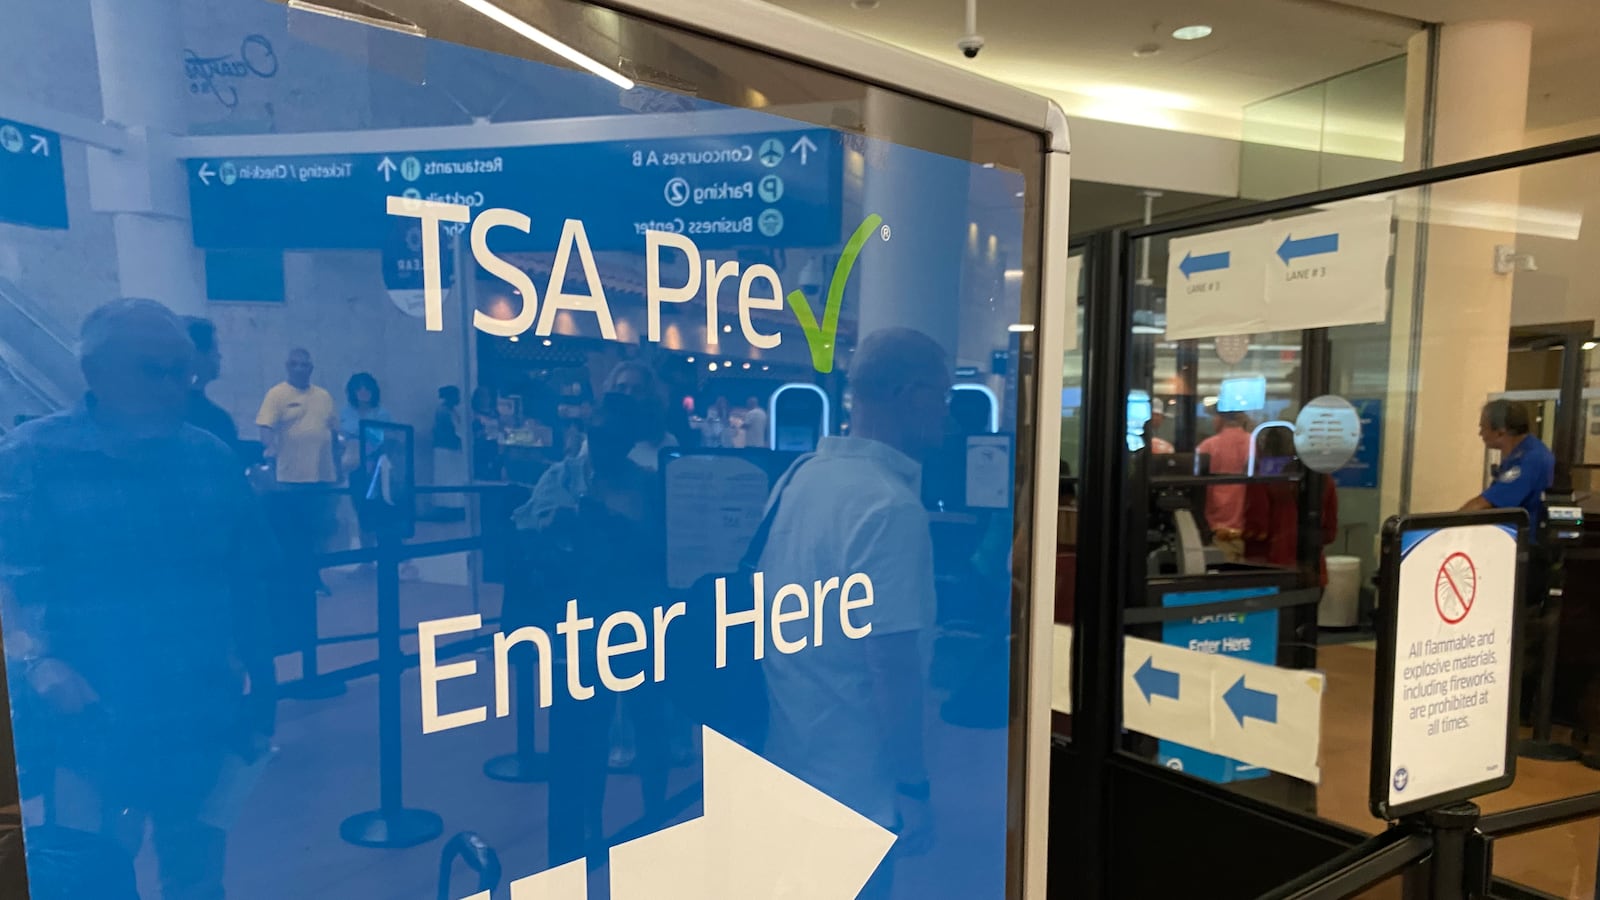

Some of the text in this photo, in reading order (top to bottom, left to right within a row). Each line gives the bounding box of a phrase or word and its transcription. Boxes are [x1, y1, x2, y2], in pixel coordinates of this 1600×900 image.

[386, 195, 618, 341] TSA
[646, 228, 784, 350] Pre
[1285, 268, 1310, 282] LANE
[1320, 267, 1327, 278] 3
[1186, 283, 1207, 295] LANE
[418, 571, 874, 735] Enter Here
[1189, 637, 1251, 654] Enter Here
[1409, 630, 1495, 659] All flammable and
[1403, 658, 1451, 681] explosive
[1403, 680, 1448, 701] including
[1409, 691, 1489, 721] are prohibited at
[1427, 716, 1470, 737] all times.
